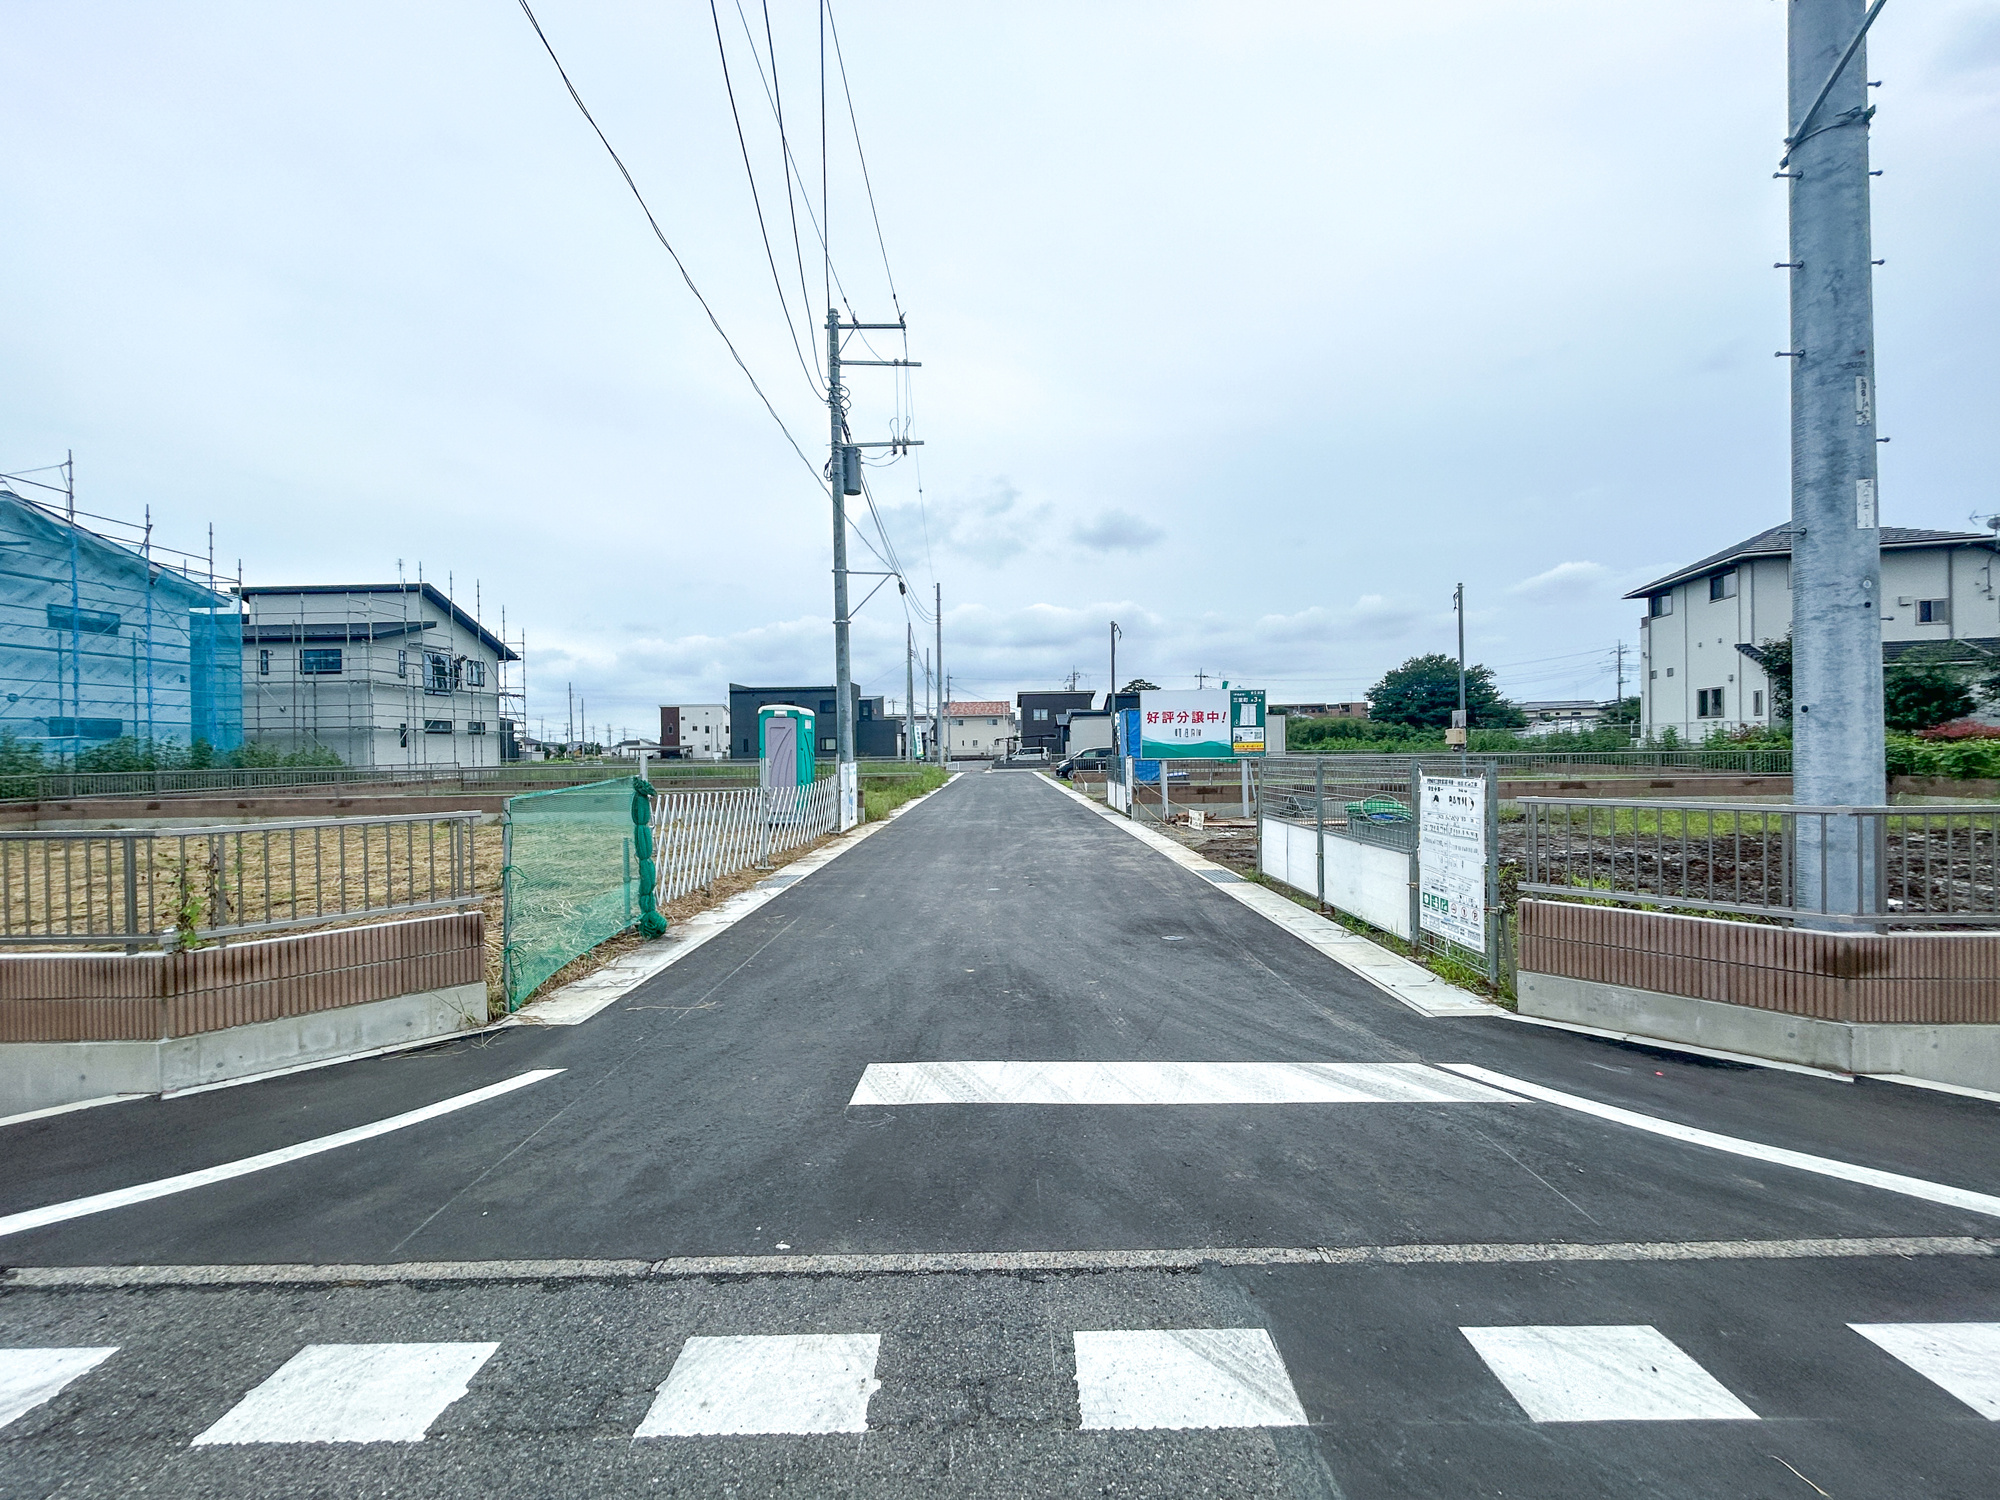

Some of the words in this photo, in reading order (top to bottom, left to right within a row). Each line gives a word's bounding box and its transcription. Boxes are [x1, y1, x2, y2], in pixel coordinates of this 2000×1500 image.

[1146, 711, 1227, 724] 好評分譲中!
